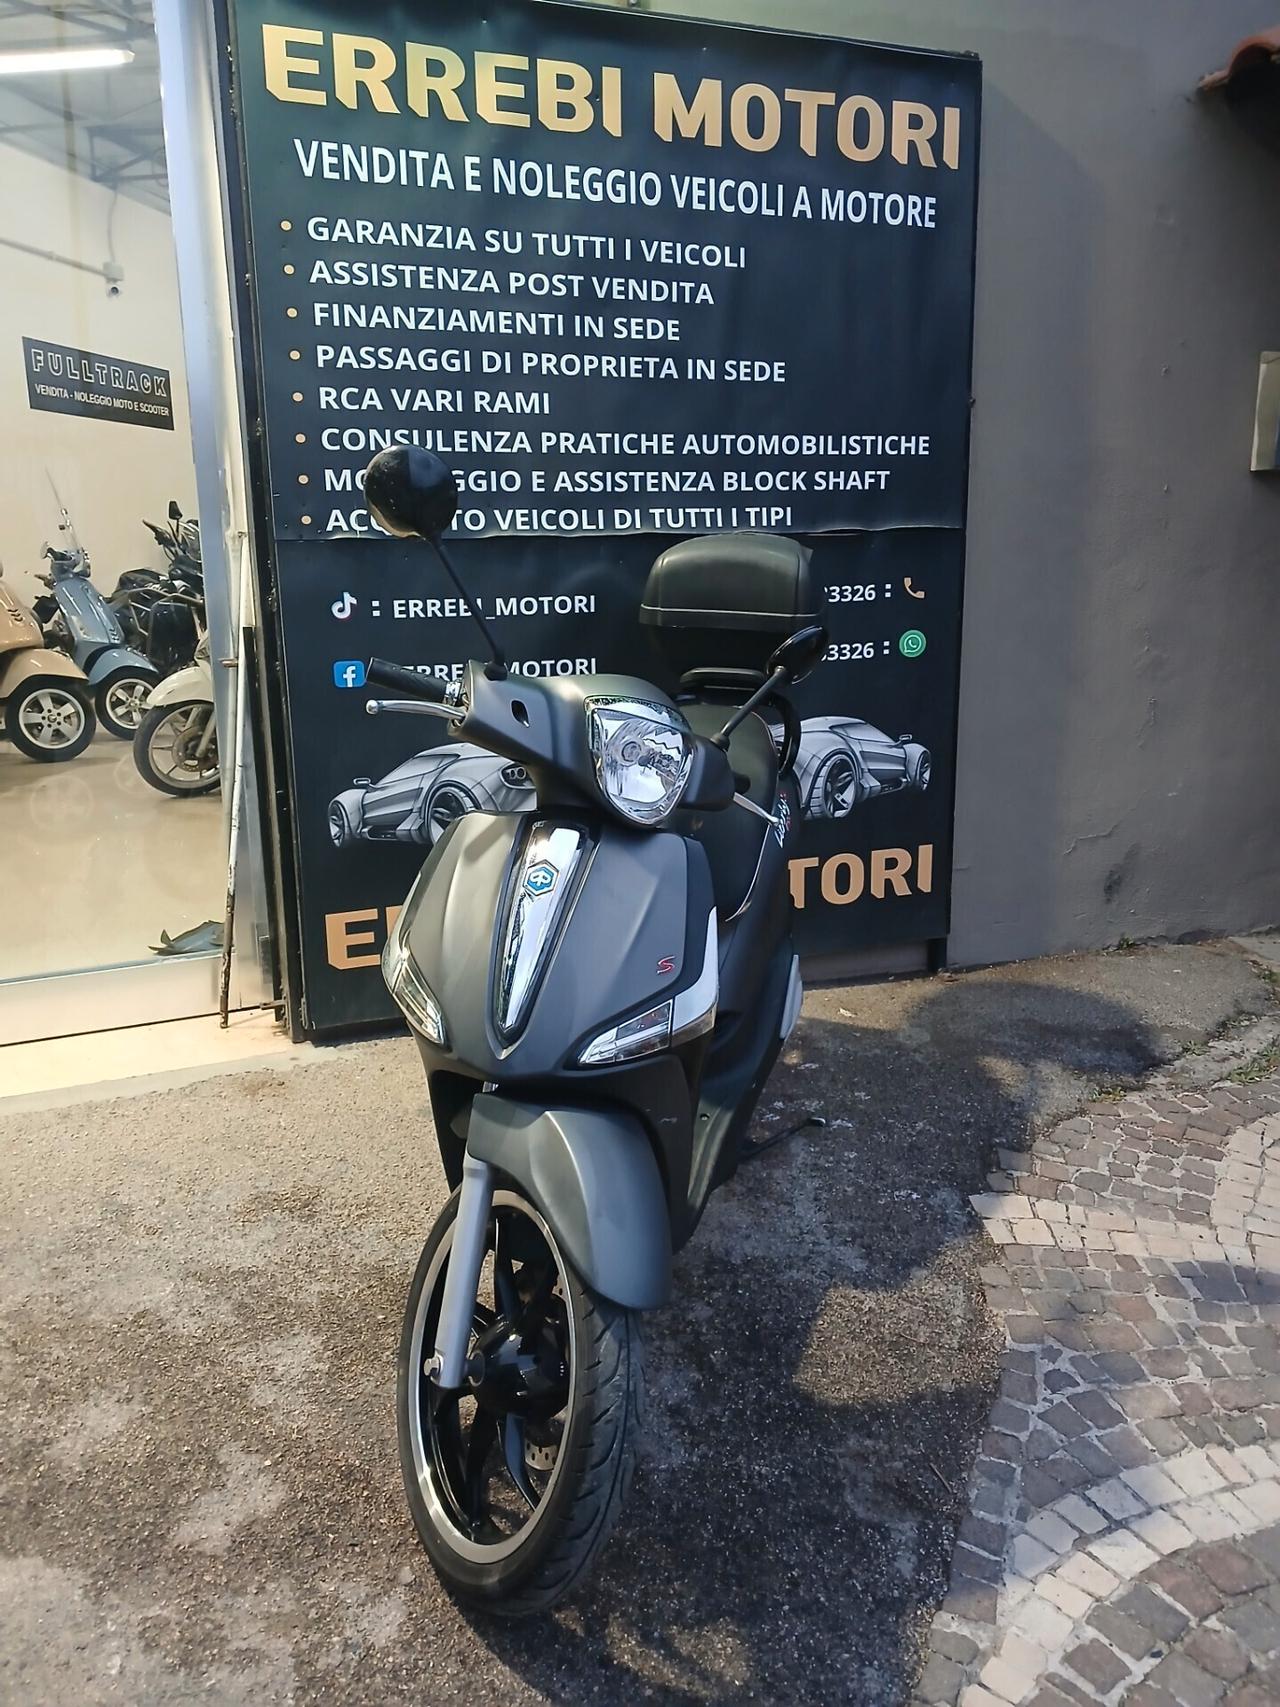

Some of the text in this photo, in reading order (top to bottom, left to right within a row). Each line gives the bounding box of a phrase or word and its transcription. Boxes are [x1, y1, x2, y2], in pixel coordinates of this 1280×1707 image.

[262, 23, 960, 170] ERREBI MOTORI
[293, 138, 937, 229] VENDITA E NOLEGGIO VEICOLI A MOTORE
[307, 216, 746, 269] GARANZIA SU TUTTI I VEICOLI
[309, 259, 715, 305] ASSISTENZA POST VENDITA
[313, 302, 680, 341] FINANZIAMENTI IN SEDE
[32, 349, 167, 397] FULLTRACK
[316, 344, 786, 383] PASSAGGI DI PROPRIETA IN SEDE
[35, 384, 69, 399] VENDITA
[74, 391, 112, 407] NOLEGGIO
[113, 399, 133, 411] MOTO
[133, 402, 139, 411] E
[139, 402, 170, 417] SCOOTER
[319, 386, 550, 415] RCA VARI RAMI
[321, 428, 930, 456] CONSULENZA PRATICHE AUTOMOBILISTICHE
[531, 470, 546, 492] E
[553, 471, 716, 493] ASSISTENZA
[723, 470, 806, 492] BLOCK
[813, 470, 890, 491] SHAFT
[493, 508, 606, 533] VEICOLI
[614, 508, 643, 532] DI
[649, 507, 723, 531] TUTTI
[731, 507, 738, 530] I
[744, 506, 792, 529] TIPI
[824, 584, 876, 603] 3326
[821, 642, 875, 662] 3326
[656, 954, 676, 975] S
